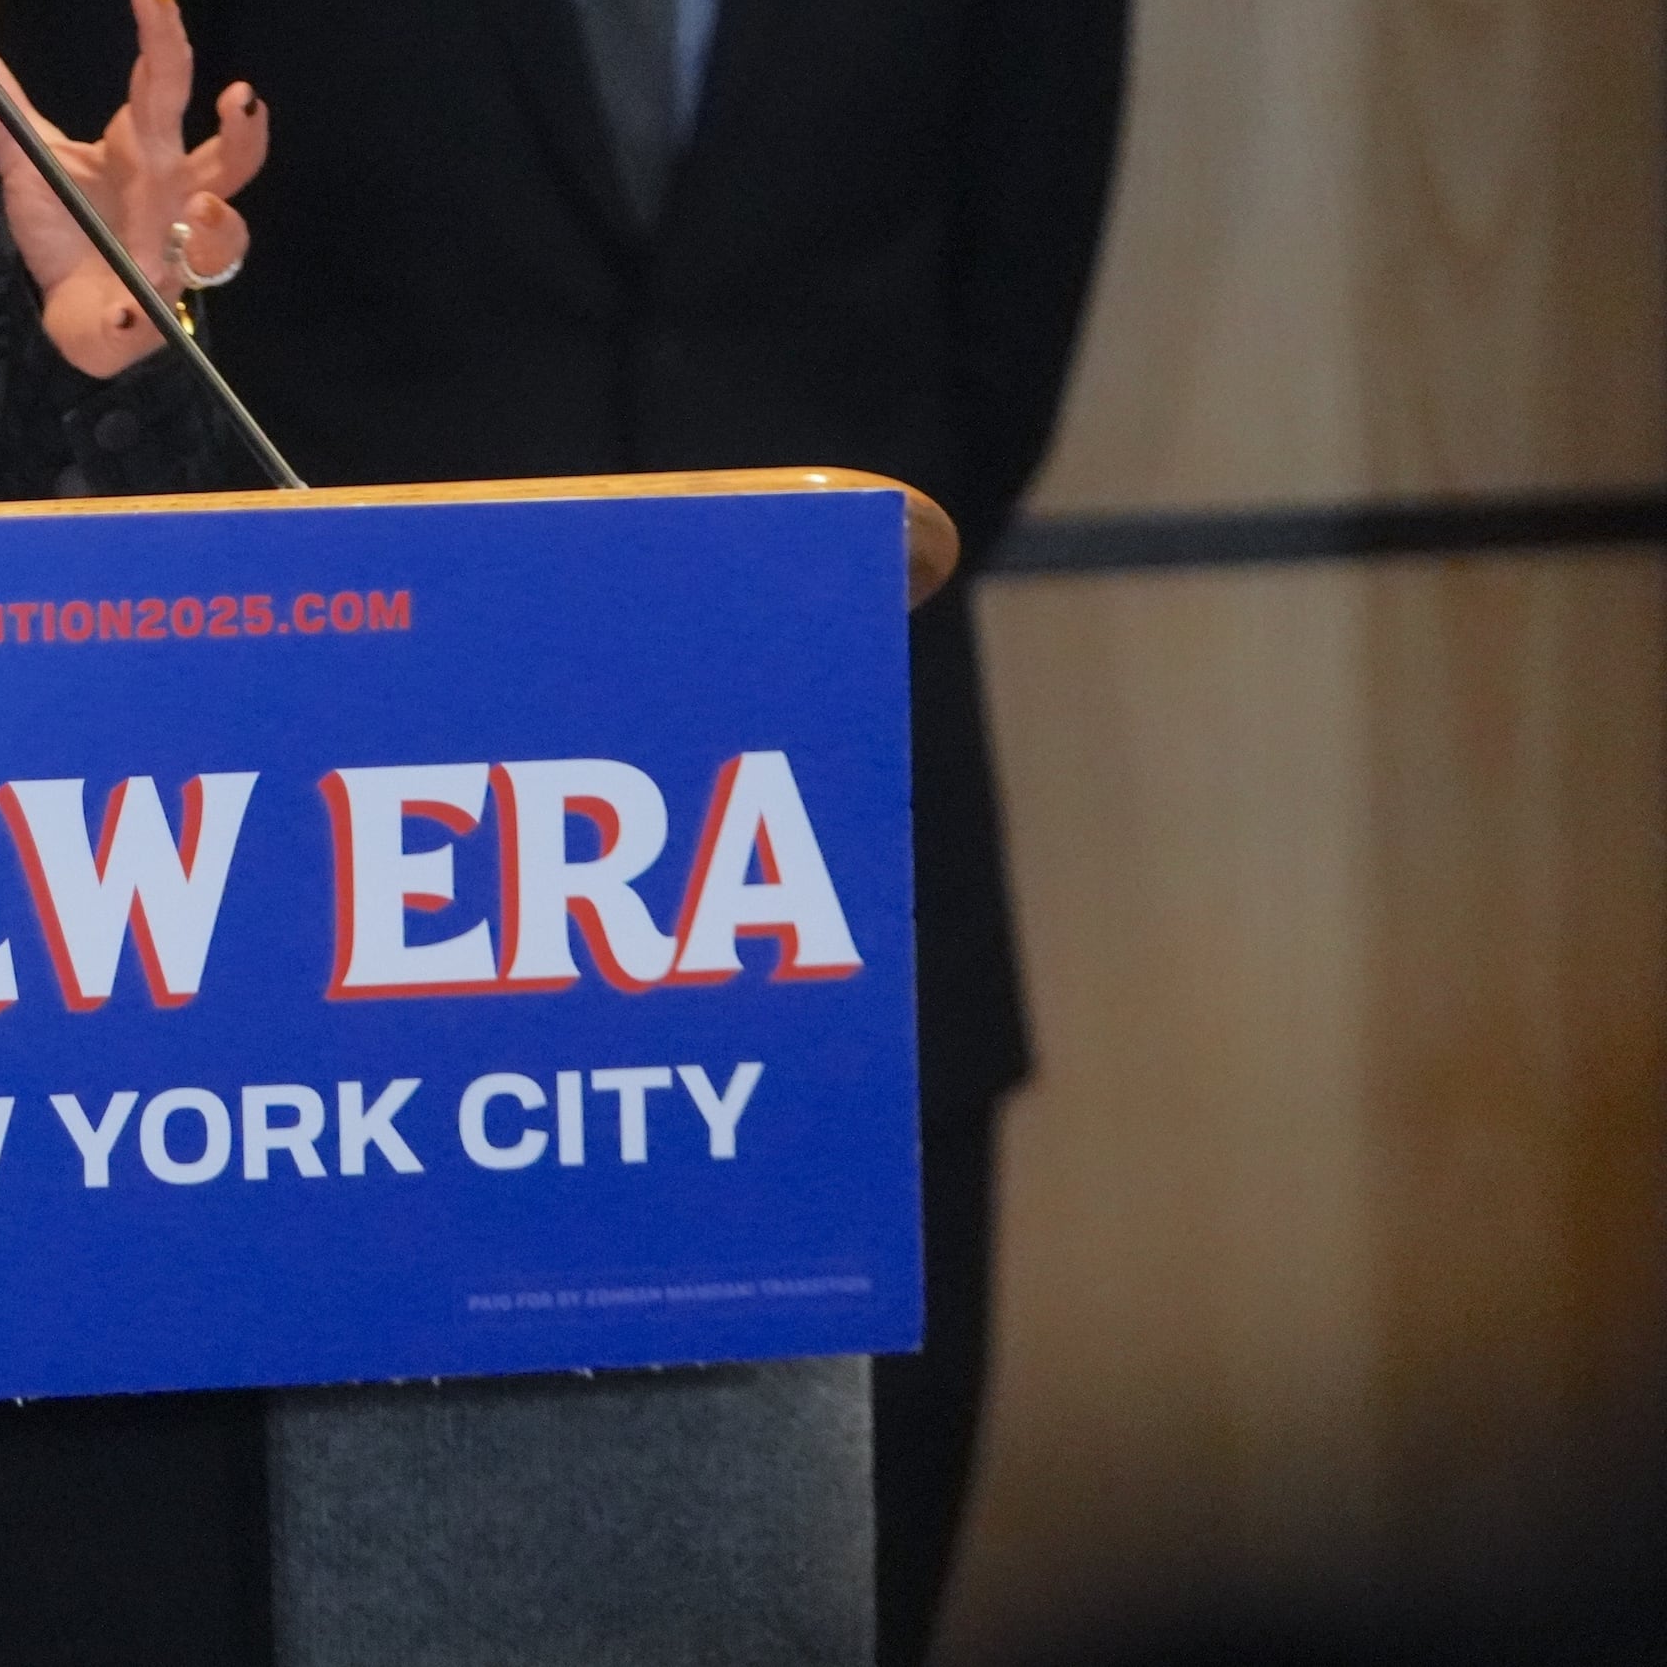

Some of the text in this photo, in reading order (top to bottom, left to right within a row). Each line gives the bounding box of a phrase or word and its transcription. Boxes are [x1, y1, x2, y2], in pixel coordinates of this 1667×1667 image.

[318, 749, 864, 1002] ERA
[49, 1077, 425, 1189] YORK
[457, 1061, 763, 1170] CITY
